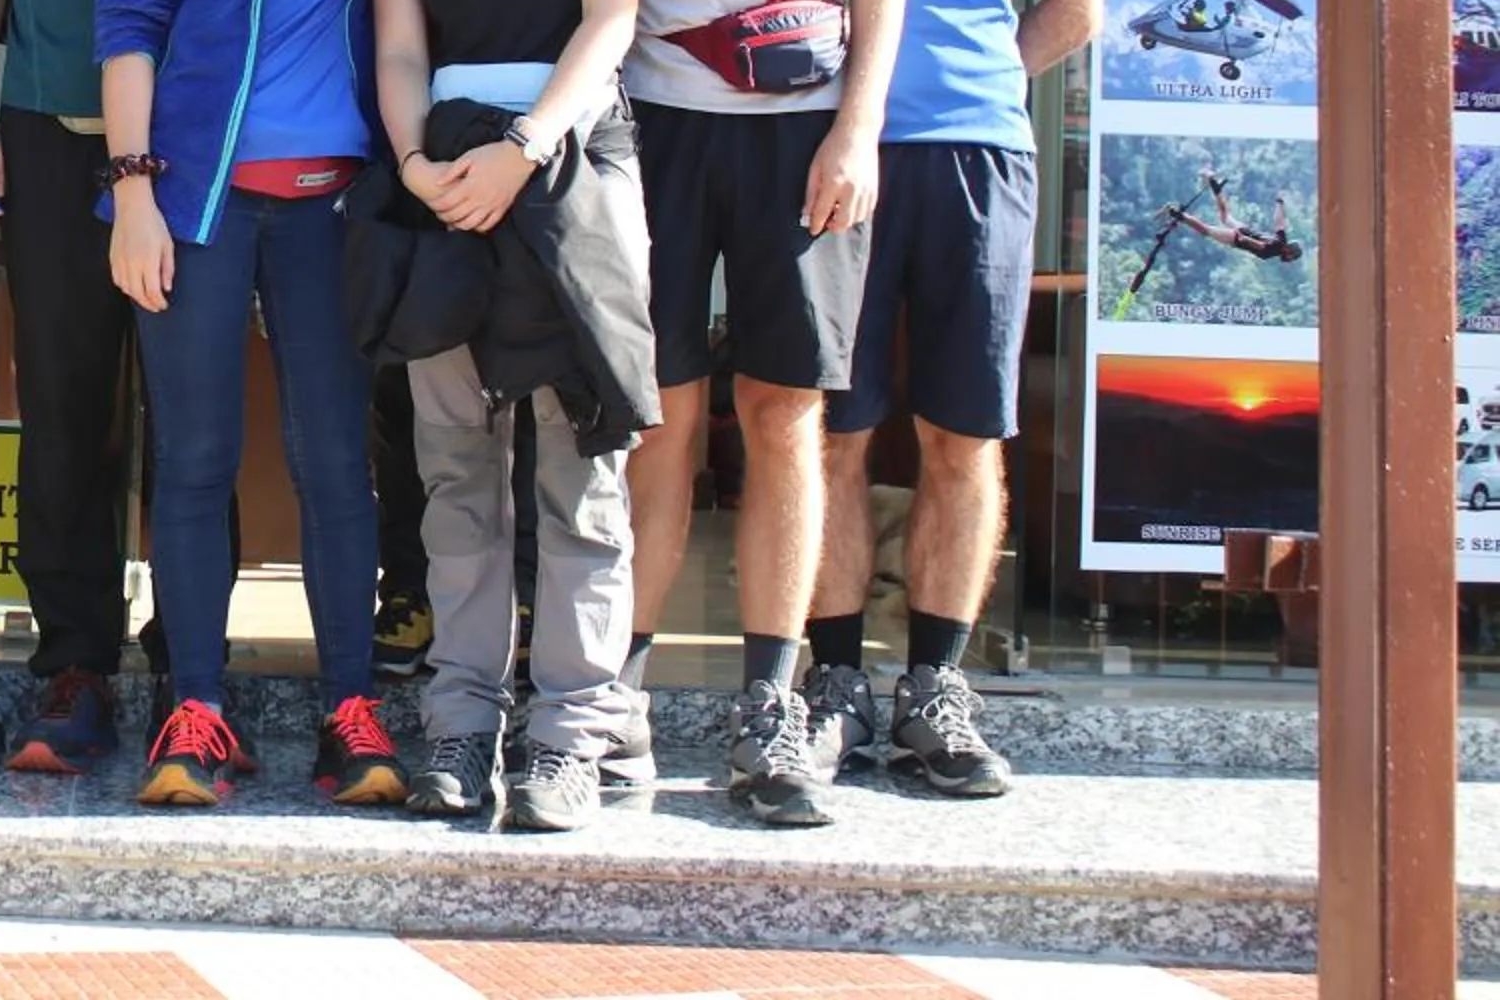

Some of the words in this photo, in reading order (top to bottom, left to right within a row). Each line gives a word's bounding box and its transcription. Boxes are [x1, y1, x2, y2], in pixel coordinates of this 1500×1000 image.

[1156, 82, 1214, 98] ULTRA
[1220, 84, 1274, 99] LIGHT
[1155, 303, 1213, 319] BUNGY
[1221, 304, 1269, 322] JUMP
[1141, 523, 1222, 542] SUNRISE
